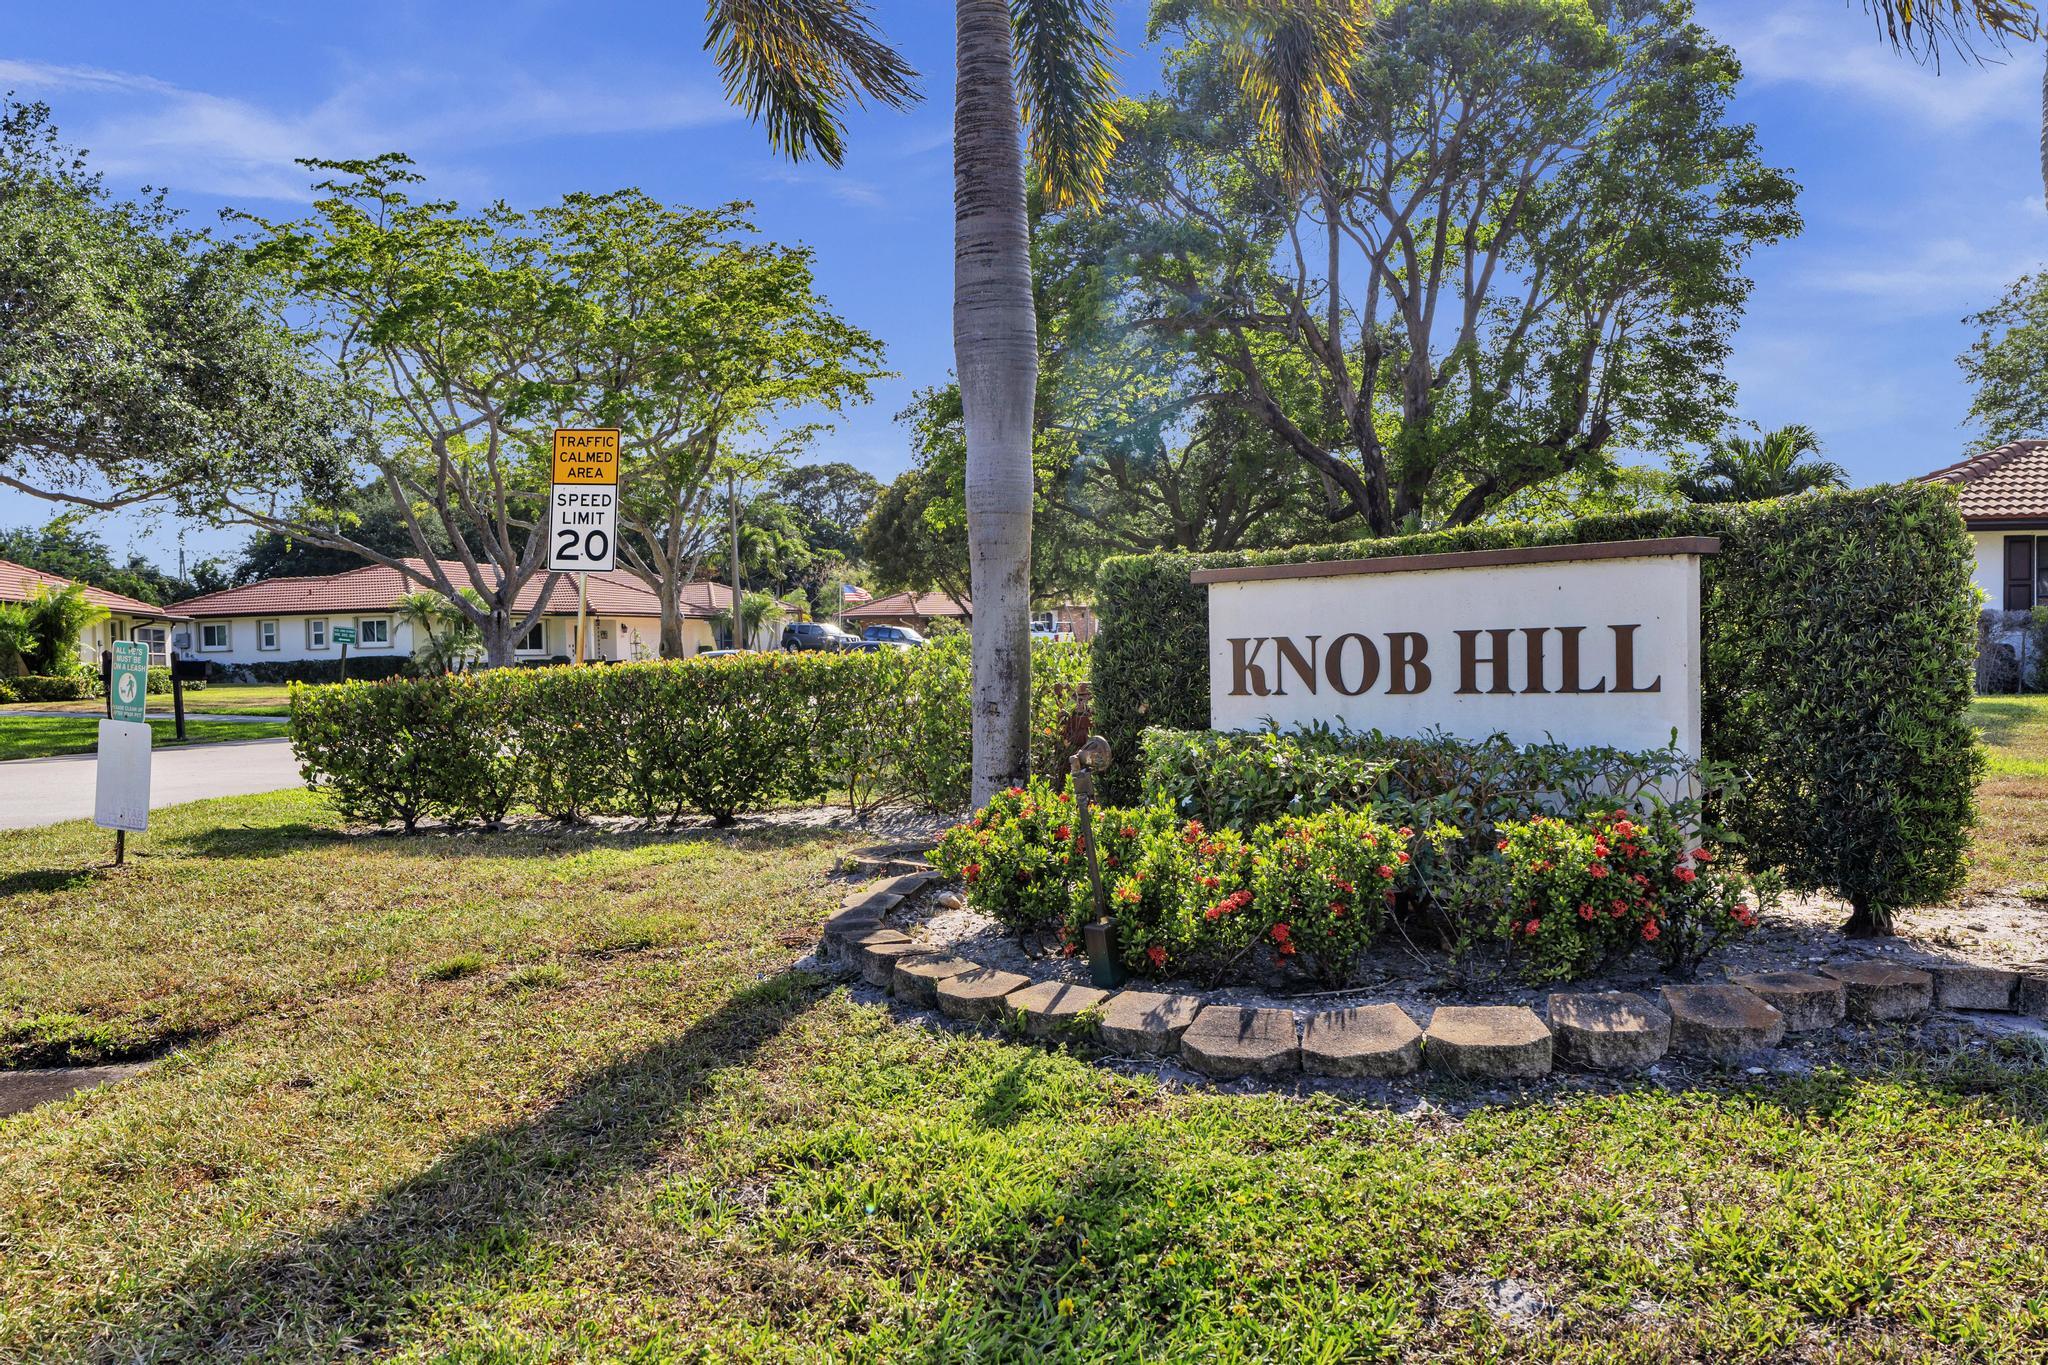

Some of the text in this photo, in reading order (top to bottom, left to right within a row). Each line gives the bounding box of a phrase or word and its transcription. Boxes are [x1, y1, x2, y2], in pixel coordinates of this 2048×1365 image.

[560, 436, 614, 448] TRAFFIC
[560, 452, 613, 463] CALMED
[567, 467, 604, 478] AREA
[557, 493, 612, 507] SPEED
[562, 511, 605, 525] LIMIT
[556, 529, 609, 561] 20
[133, 656, 142, 664] BE
[1227, 624, 1662, 697] KNOB HILL
[127, 663, 146, 672] LEASH
